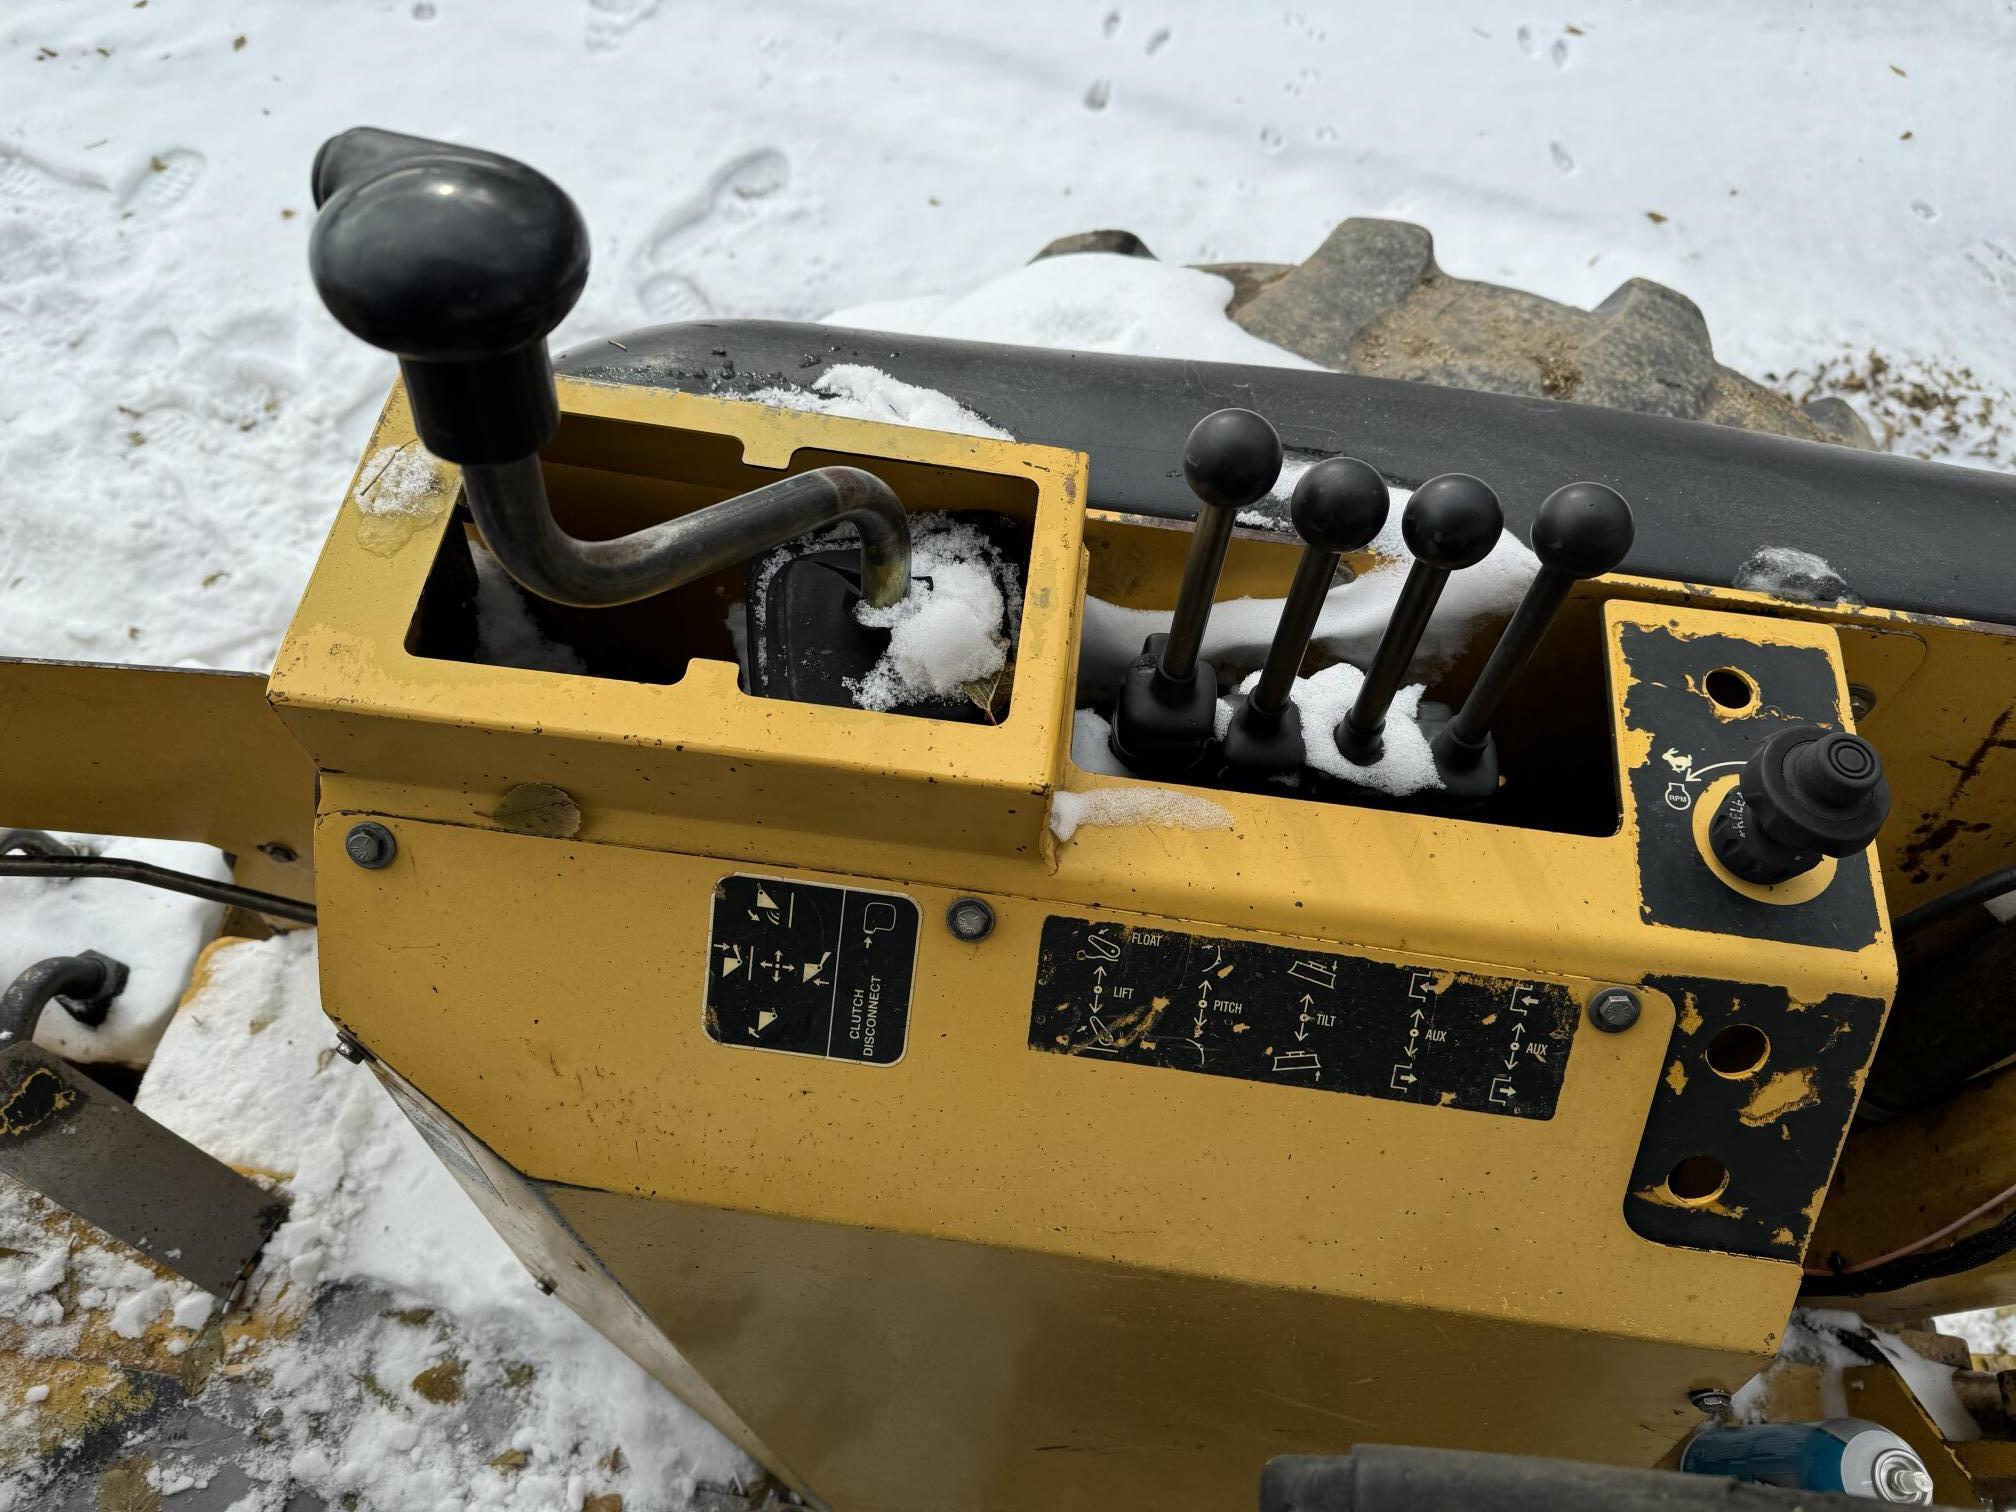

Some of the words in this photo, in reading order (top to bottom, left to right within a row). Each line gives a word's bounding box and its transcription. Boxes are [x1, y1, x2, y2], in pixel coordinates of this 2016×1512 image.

[1669, 794, 1688, 803] RPM
[1131, 932, 1163, 947] FLOAT
[1113, 986, 1135, 999] LIFT
[849, 989, 865, 1039] CLUTCH
[1213, 1000, 1243, 1014] PITCH
[863, 975, 881, 1056] DISCONNECT
[1316, 1014, 1337, 1028] TILT
[1425, 1029, 1447, 1042] AUX
[1526, 1043, 1548, 1056] AUX
